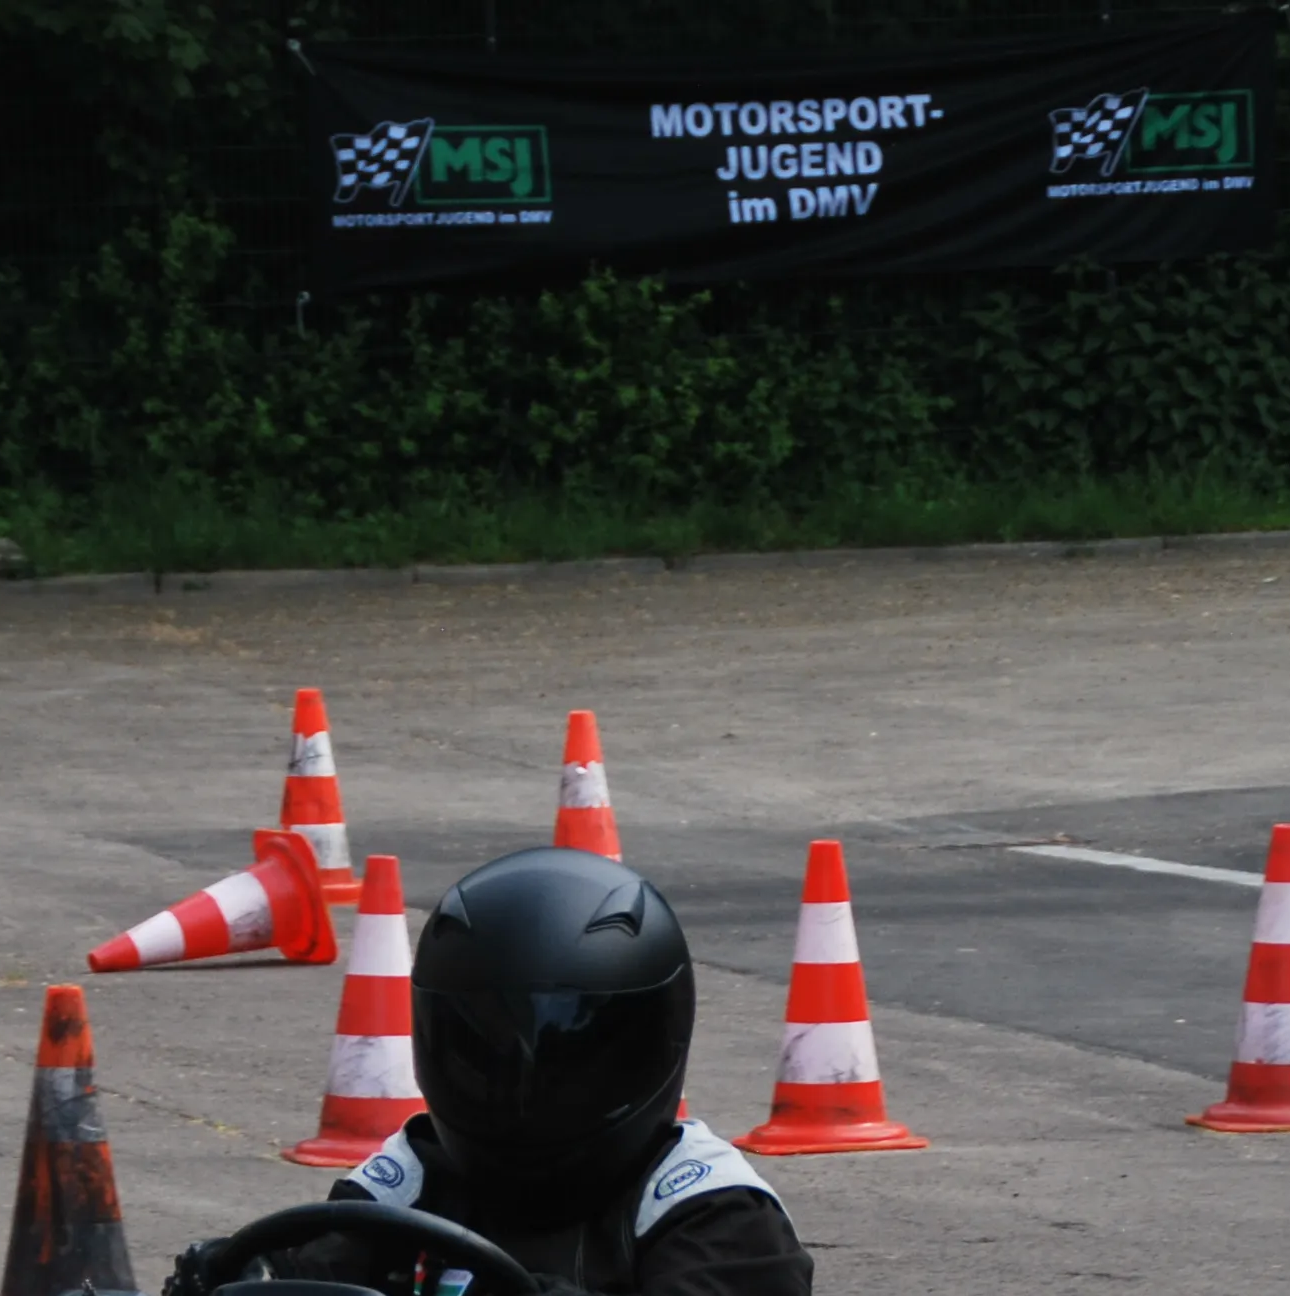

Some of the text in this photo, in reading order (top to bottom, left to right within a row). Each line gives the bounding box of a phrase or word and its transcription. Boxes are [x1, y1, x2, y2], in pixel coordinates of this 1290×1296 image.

[650, 94, 944, 138] MOTORSPORT-
[1142, 101, 1237, 163] MSJ
[430, 137, 533, 196] MSJ
[716, 141, 883, 181] JUGEND
[728, 182, 879, 223] im DMV
